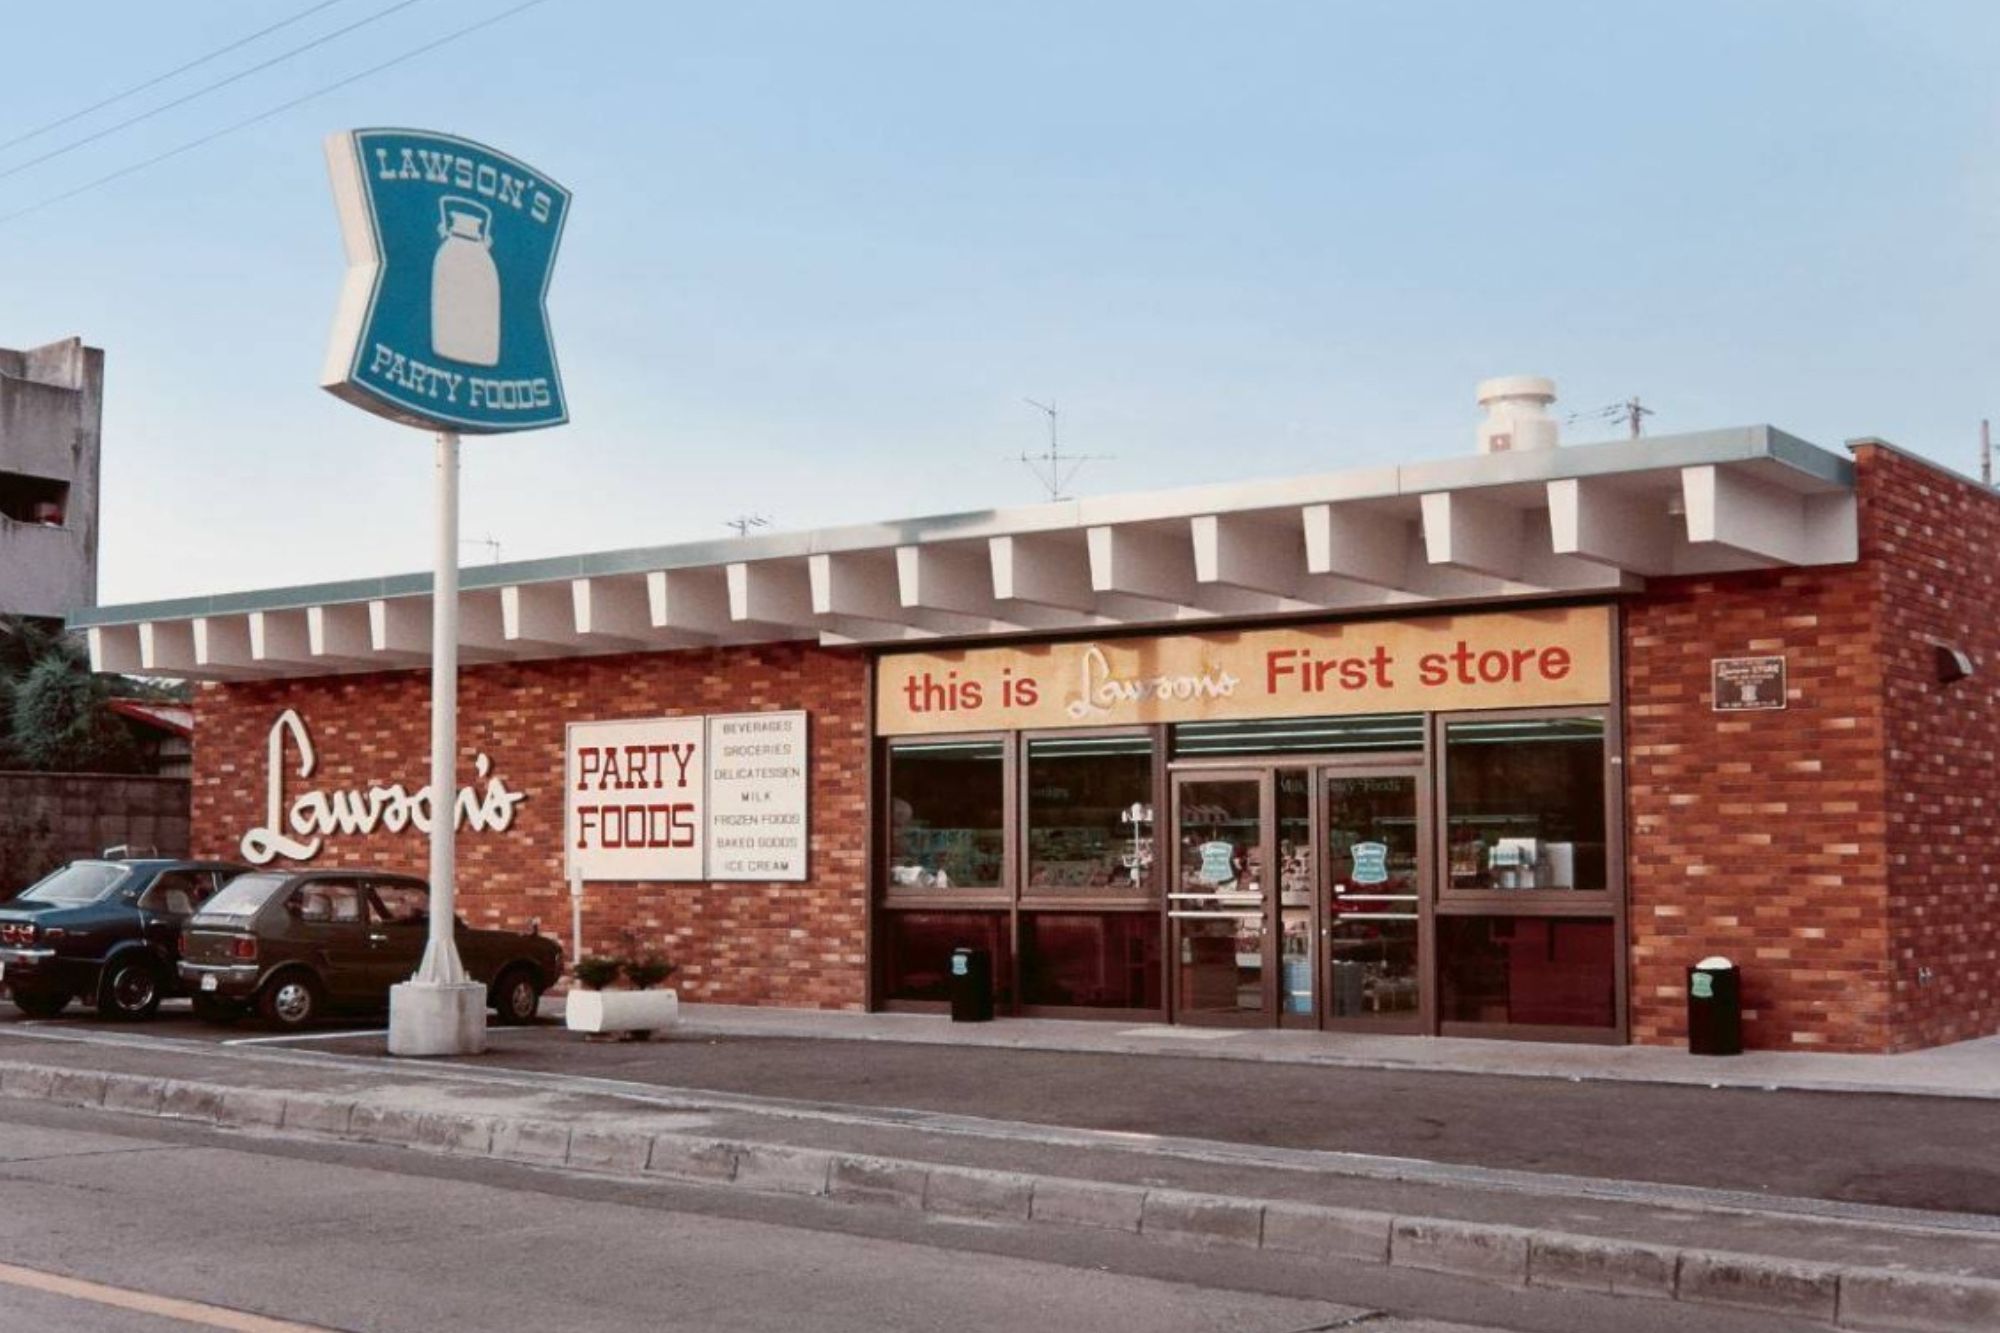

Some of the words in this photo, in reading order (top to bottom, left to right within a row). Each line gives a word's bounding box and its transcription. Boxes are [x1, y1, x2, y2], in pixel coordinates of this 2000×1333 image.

[375, 148, 551, 224] LAWSON'S
[370, 343, 461, 402] PARTY
[468, 376, 550, 409] FOODS
[903, 671, 982, 712] this
[1002, 668, 1038, 708] is
[1266, 646, 1393, 694] First
[1418, 640, 1571, 686] store
[577, 744, 695, 790] PARTY
[714, 767, 800, 780] DELICATESSEN
[741, 791, 772, 802] MILK
[577, 803, 694, 848] FOODS
